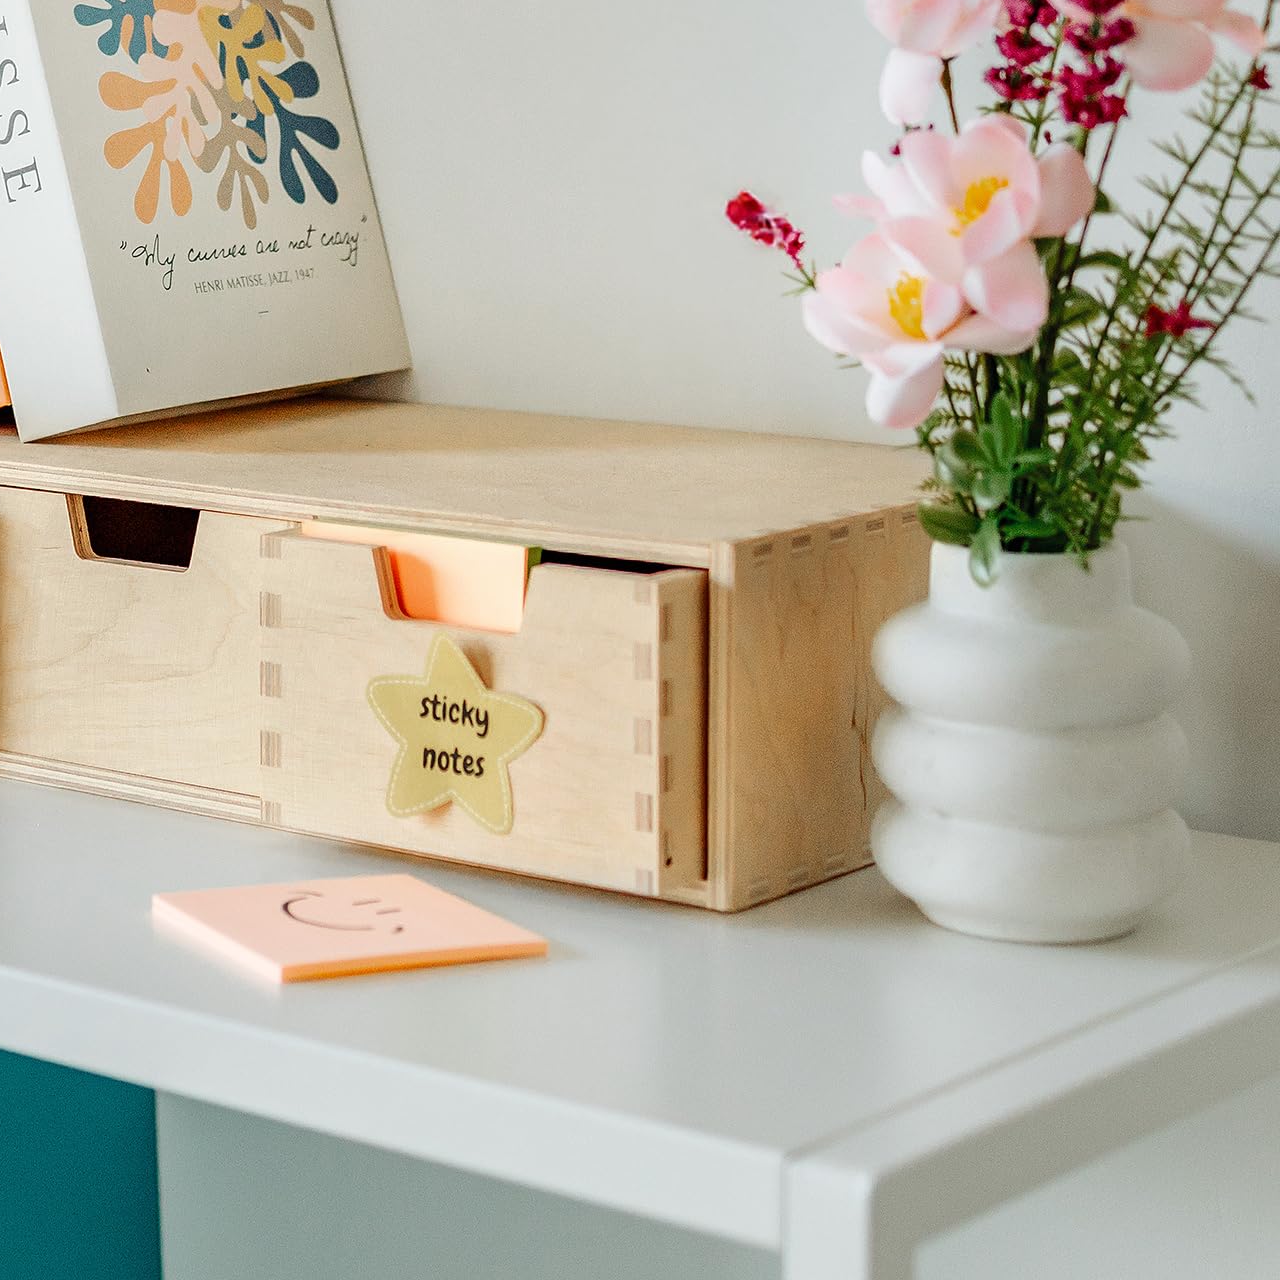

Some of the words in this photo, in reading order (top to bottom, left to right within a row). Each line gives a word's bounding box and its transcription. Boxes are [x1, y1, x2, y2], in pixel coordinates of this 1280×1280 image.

[256, 240, 280, 254] are
[288, 224, 317, 250] not
[194, 279, 224, 294] HENRI
[295, 267, 315, 281] 1947
[420, 694, 489, 738] sticky
[422, 747, 485, 777] notes
